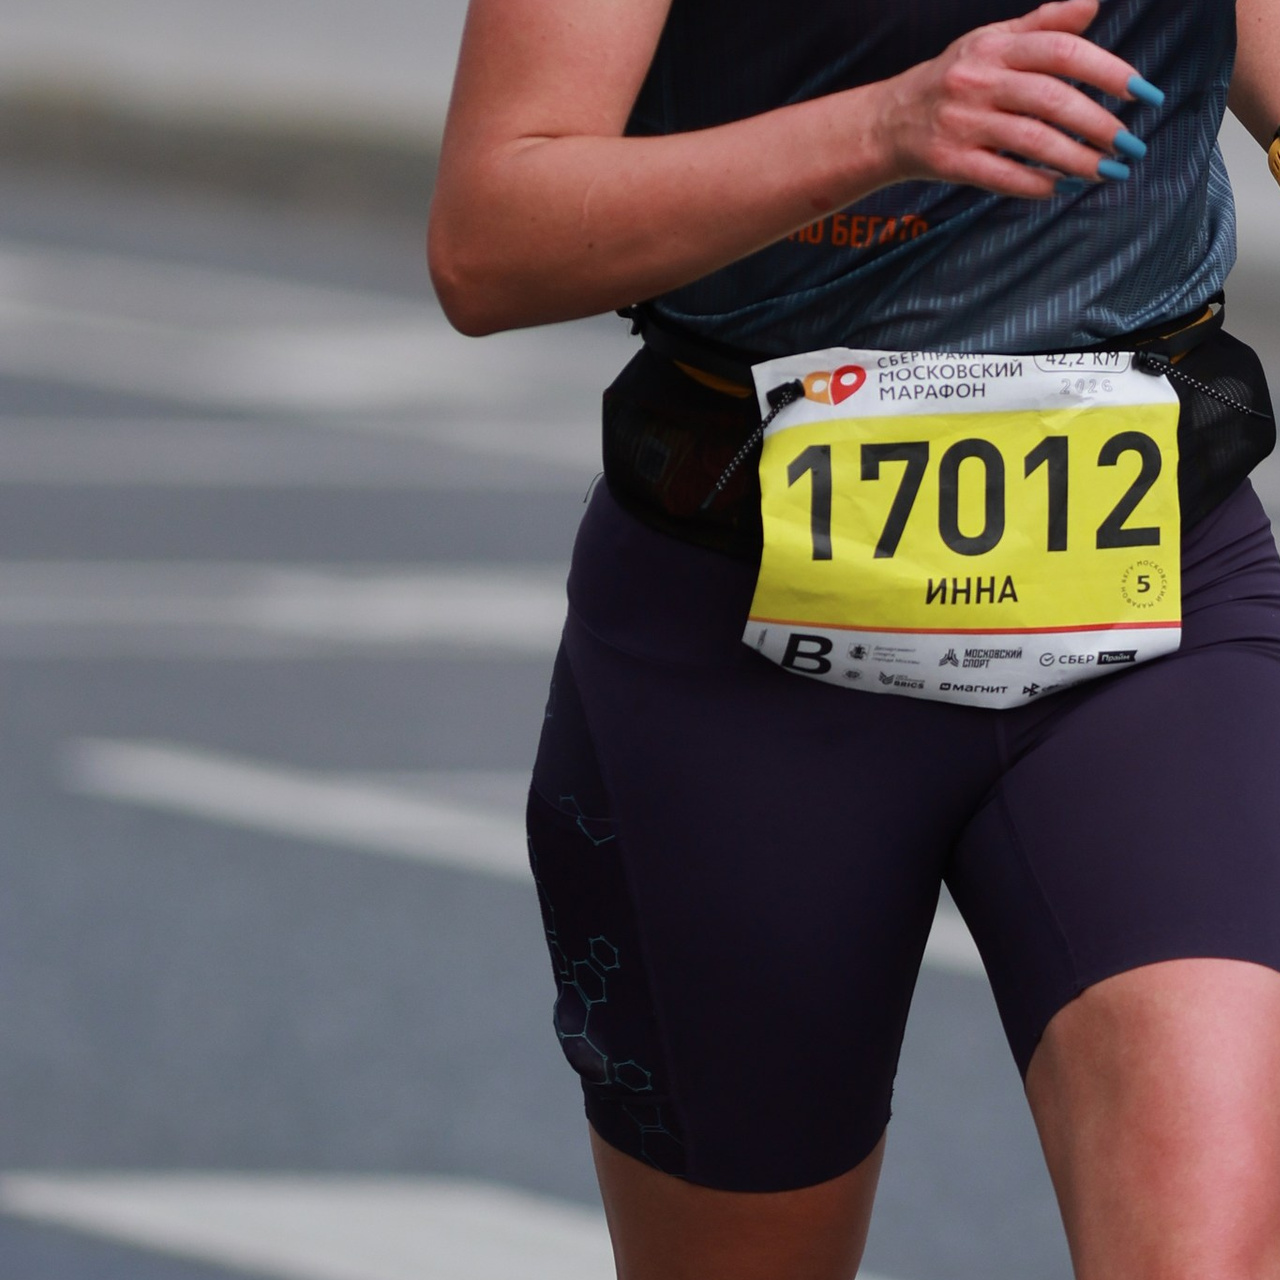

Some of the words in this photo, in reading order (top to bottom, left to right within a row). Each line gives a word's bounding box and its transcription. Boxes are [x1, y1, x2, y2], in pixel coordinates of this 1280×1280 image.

[878, 359, 1023, 384] МОСКОВСКИЙ
[879, 383, 986, 401] МАРАФОН
[787, 431, 1163, 561] 17012
[925, 575, 1019, 605] ИННА
[1136, 574, 1151, 594] 5
[963, 647, 1023, 659] МОСКОВСКИЙ
[1058, 654, 1095, 664] СБЕР
[961, 658, 990, 669] СПОРТ
